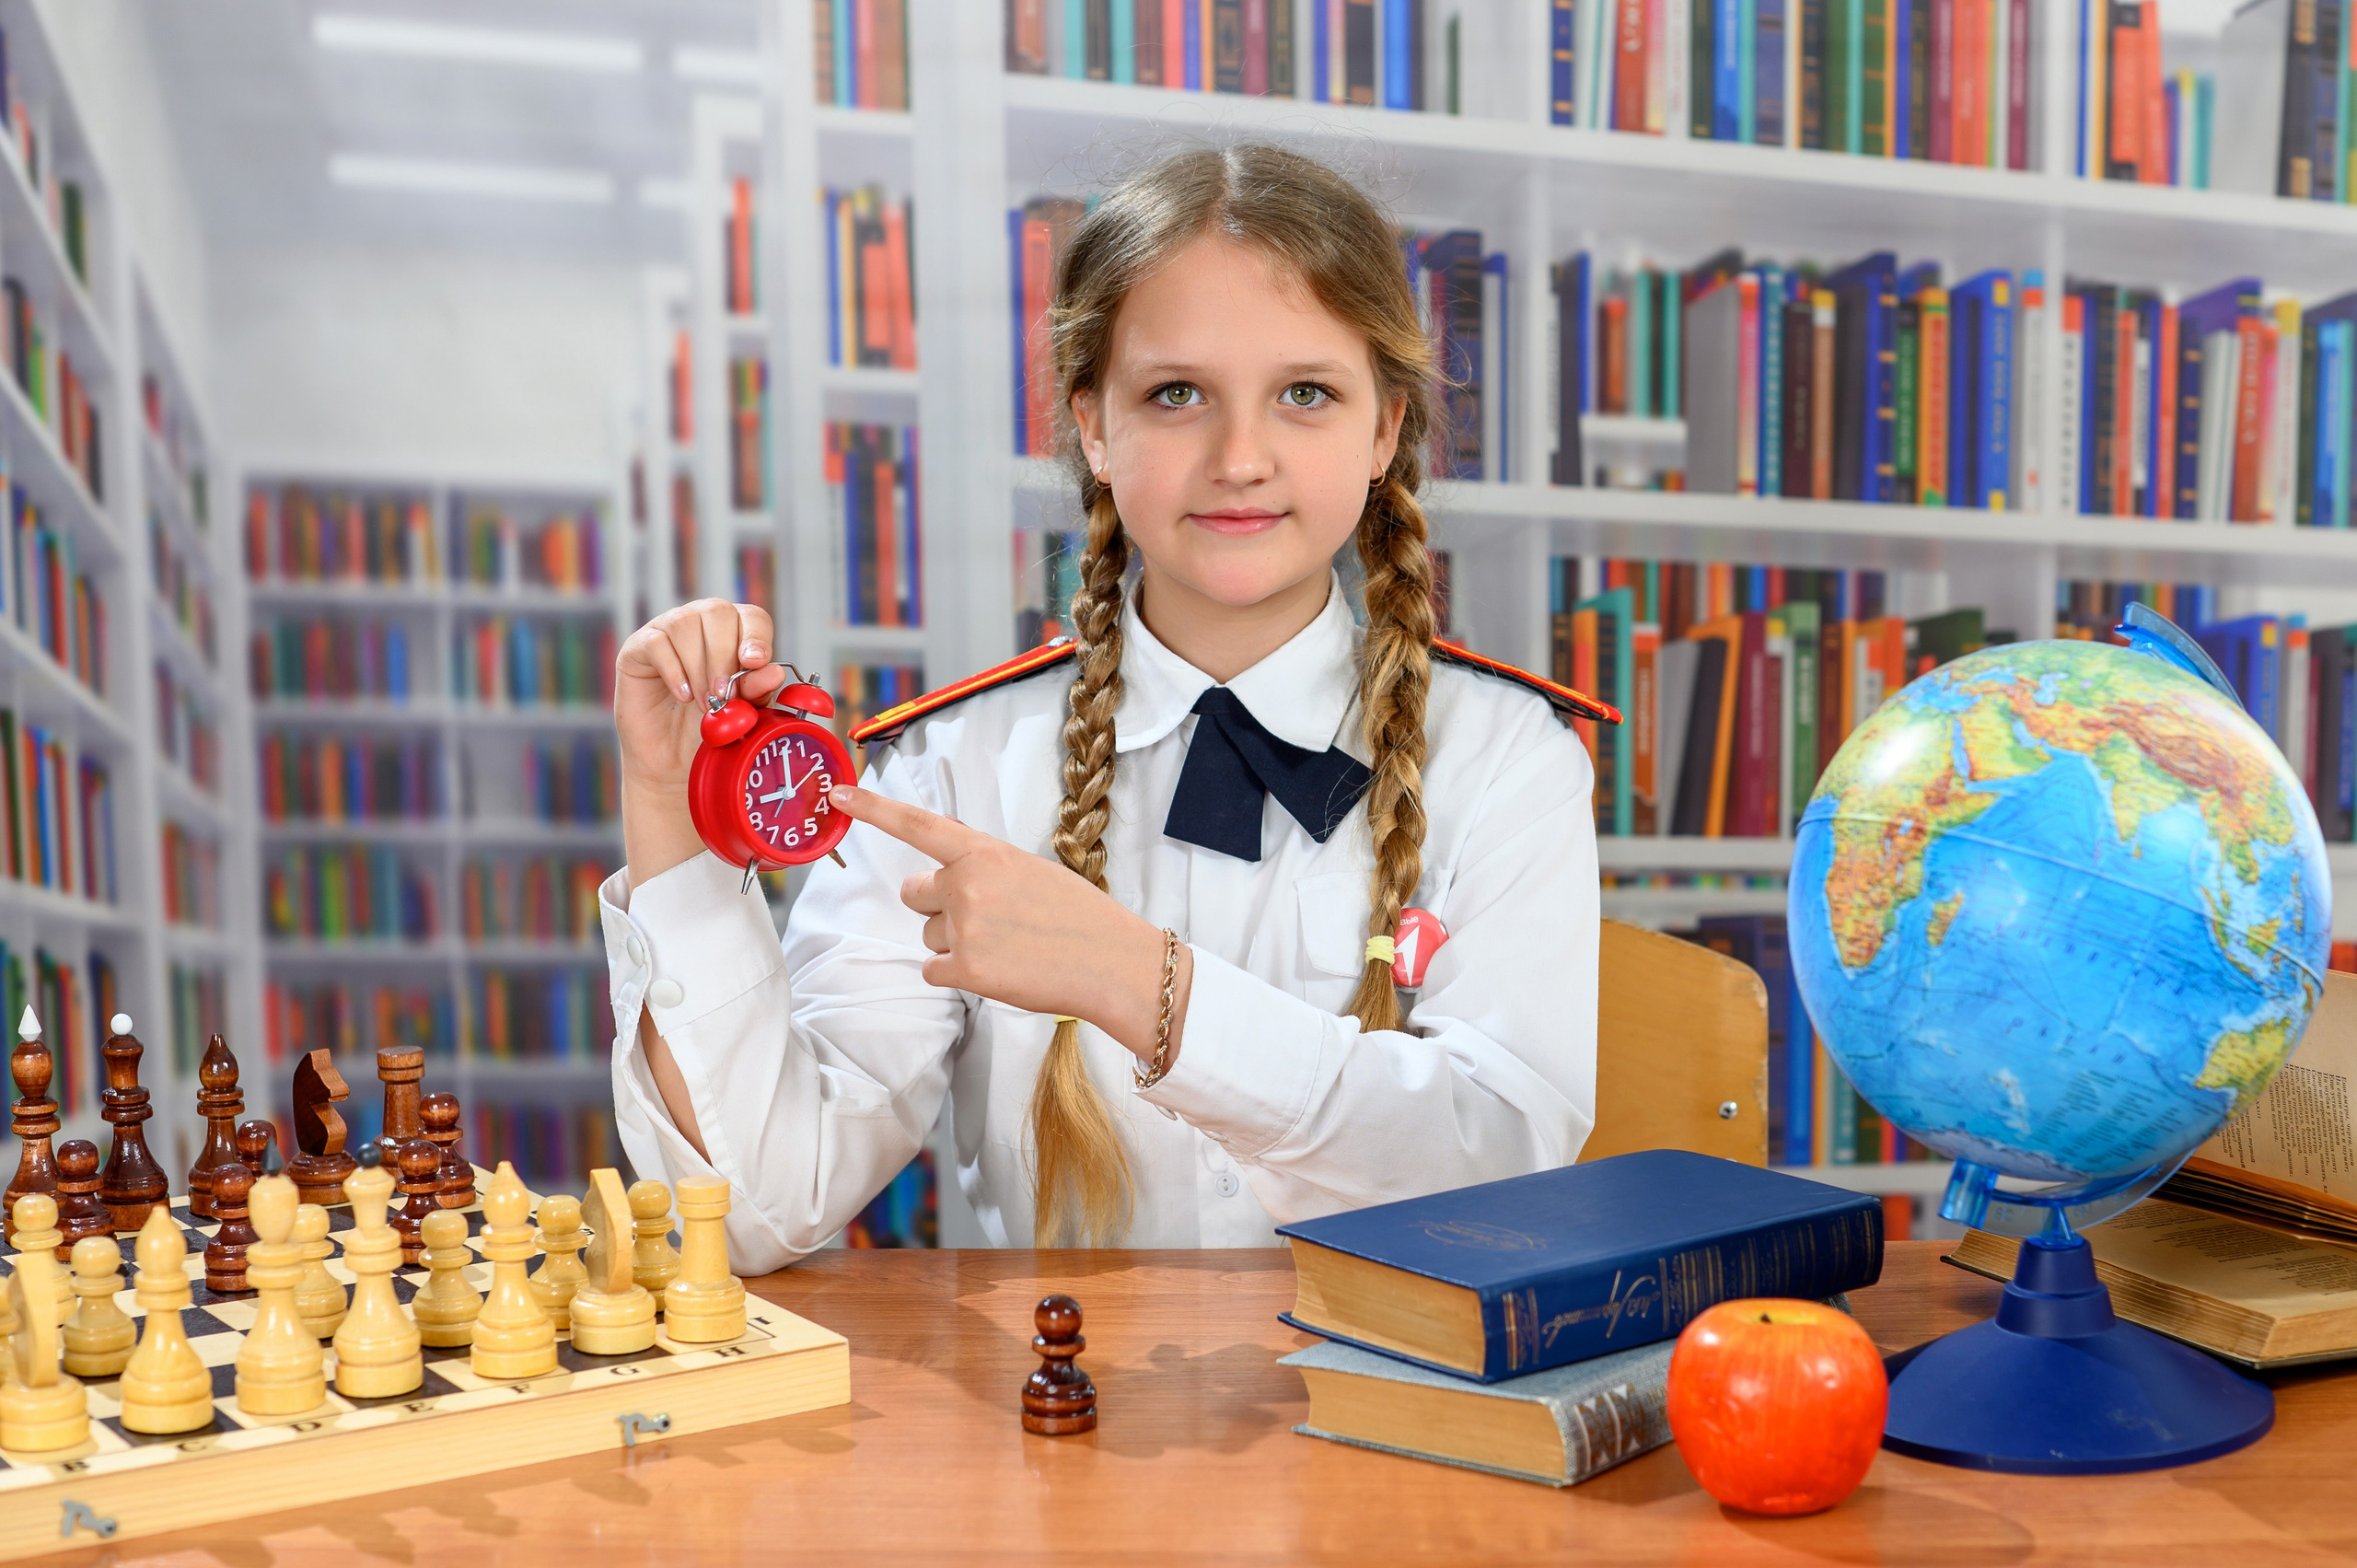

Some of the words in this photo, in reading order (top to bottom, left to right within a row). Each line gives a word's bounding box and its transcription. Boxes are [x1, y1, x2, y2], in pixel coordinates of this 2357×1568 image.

[769, 737, 792, 758] 12
[796, 740, 806, 758] 1
[810, 752, 824, 771] 2
[818, 773, 832, 792] 3
[814, 796, 830, 815] 4
[749, 812, 763, 831] 8
[804, 817, 818, 836] 5
[766, 825, 779, 844] 7
[784, 827, 799, 847] 6
[61, 1461, 90, 1471] B
[177, 1442, 207, 1453] C
[287, 1422, 322, 1433] D
[405, 1402, 434, 1413] E
[510, 1384, 532, 1394] F
[610, 1365, 641, 1376] G
[712, 1346, 749, 1358] H
